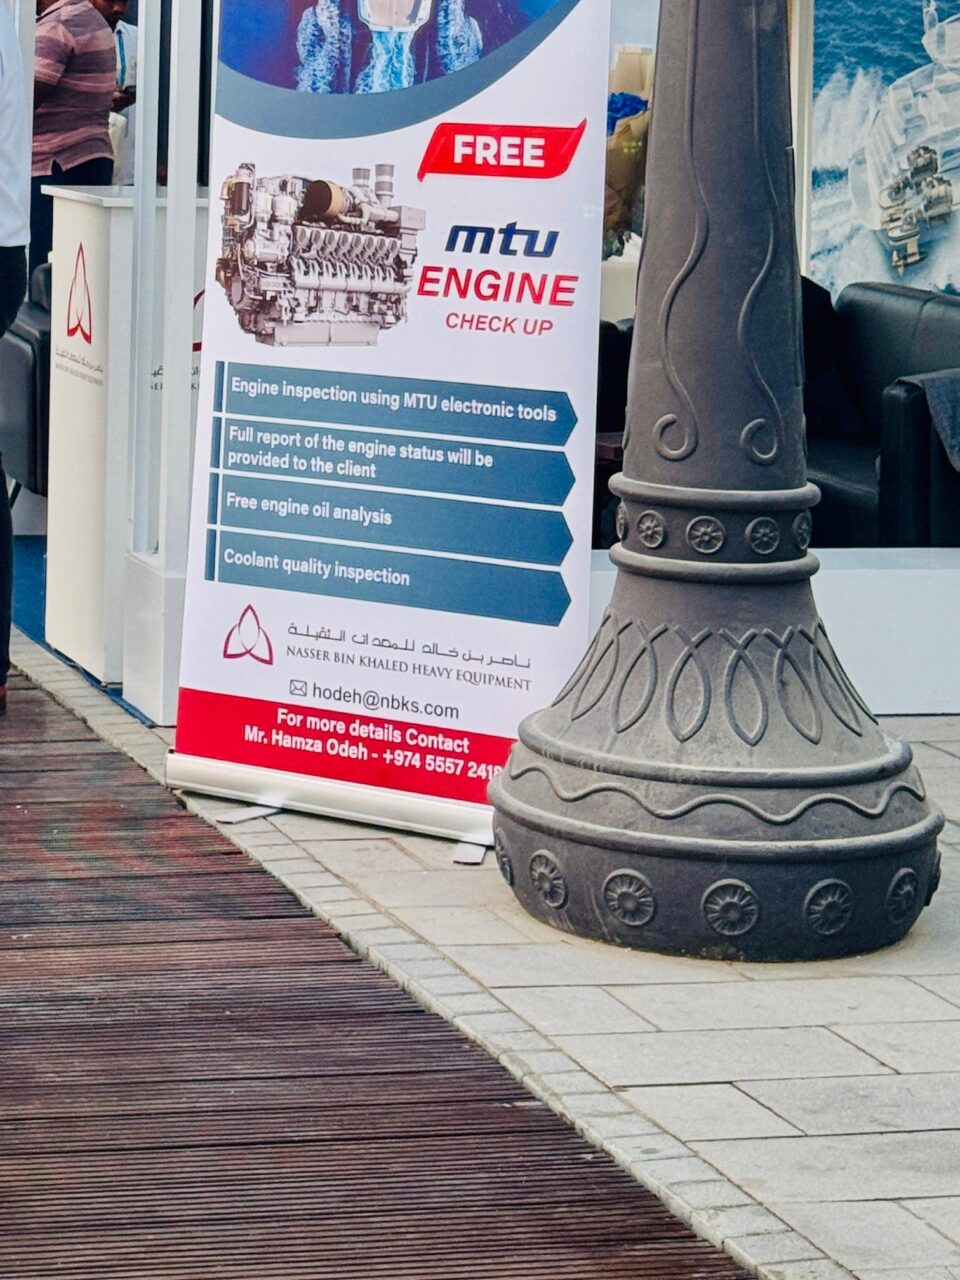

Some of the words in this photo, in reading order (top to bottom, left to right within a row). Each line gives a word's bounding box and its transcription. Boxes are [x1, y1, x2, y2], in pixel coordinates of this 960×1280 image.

[453, 134, 546, 168] FREE
[445, 221, 560, 258] mtu
[417, 265, 579, 307] ENGINE
[445, 312, 518, 334] CHECK
[523, 318, 554, 336] UP
[232, 376, 279, 397] Engine
[283, 380, 357, 405] inspection
[361, 391, 400, 411] using
[404, 392, 438, 411] MTU
[441, 395, 514, 419] electronic
[517, 404, 557, 422] tools
[228, 448, 289, 471] provided
[293, 455, 307, 470] to
[311, 455, 333, 474] the
[337, 458, 376, 478] client
[229, 425, 254, 443] Full
[257, 429, 301, 451] report
[305, 431, 320, 449] of
[322, 433, 345, 452] the
[348, 439, 396, 461] engine
[399, 443, 443, 463] status
[447, 447, 471, 466] will
[475, 449, 493, 468] be
[227, 492, 258, 511] Free
[261, 496, 309, 518] engine
[313, 500, 330, 518] oil
[333, 504, 392, 526] analysis
[224, 548, 278, 570] Coolant
[282, 555, 331, 579] quality
[334, 560, 410, 586] inspection
[287, 622, 346, 642] الثقيلة
[352, 632, 415, 652] للمعدات
[422, 642, 459, 658] خالد
[462, 651, 484, 665] بن
[487, 654, 531, 669] ناصر
[286, 645, 331, 662] NASSER
[334, 651, 355, 665] BIN
[359, 655, 409, 673] KHALED
[412, 663, 453, 680] HEAVY
[456, 670, 532, 691] EQUIPMENT
[313, 682, 460, 720] hodeh@nbks.com
[277, 707, 303, 728] For
[306, 716, 347, 735] more
[349, 718, 402, 744] details
[405, 728, 470, 754] Contact
[244, 725, 269, 745] Mr.
[271, 729, 324, 754] Hamza
[326, 737, 368, 761] Odeh
[382, 749, 421, 769] +974
[425, 754, 464, 776] 5557
